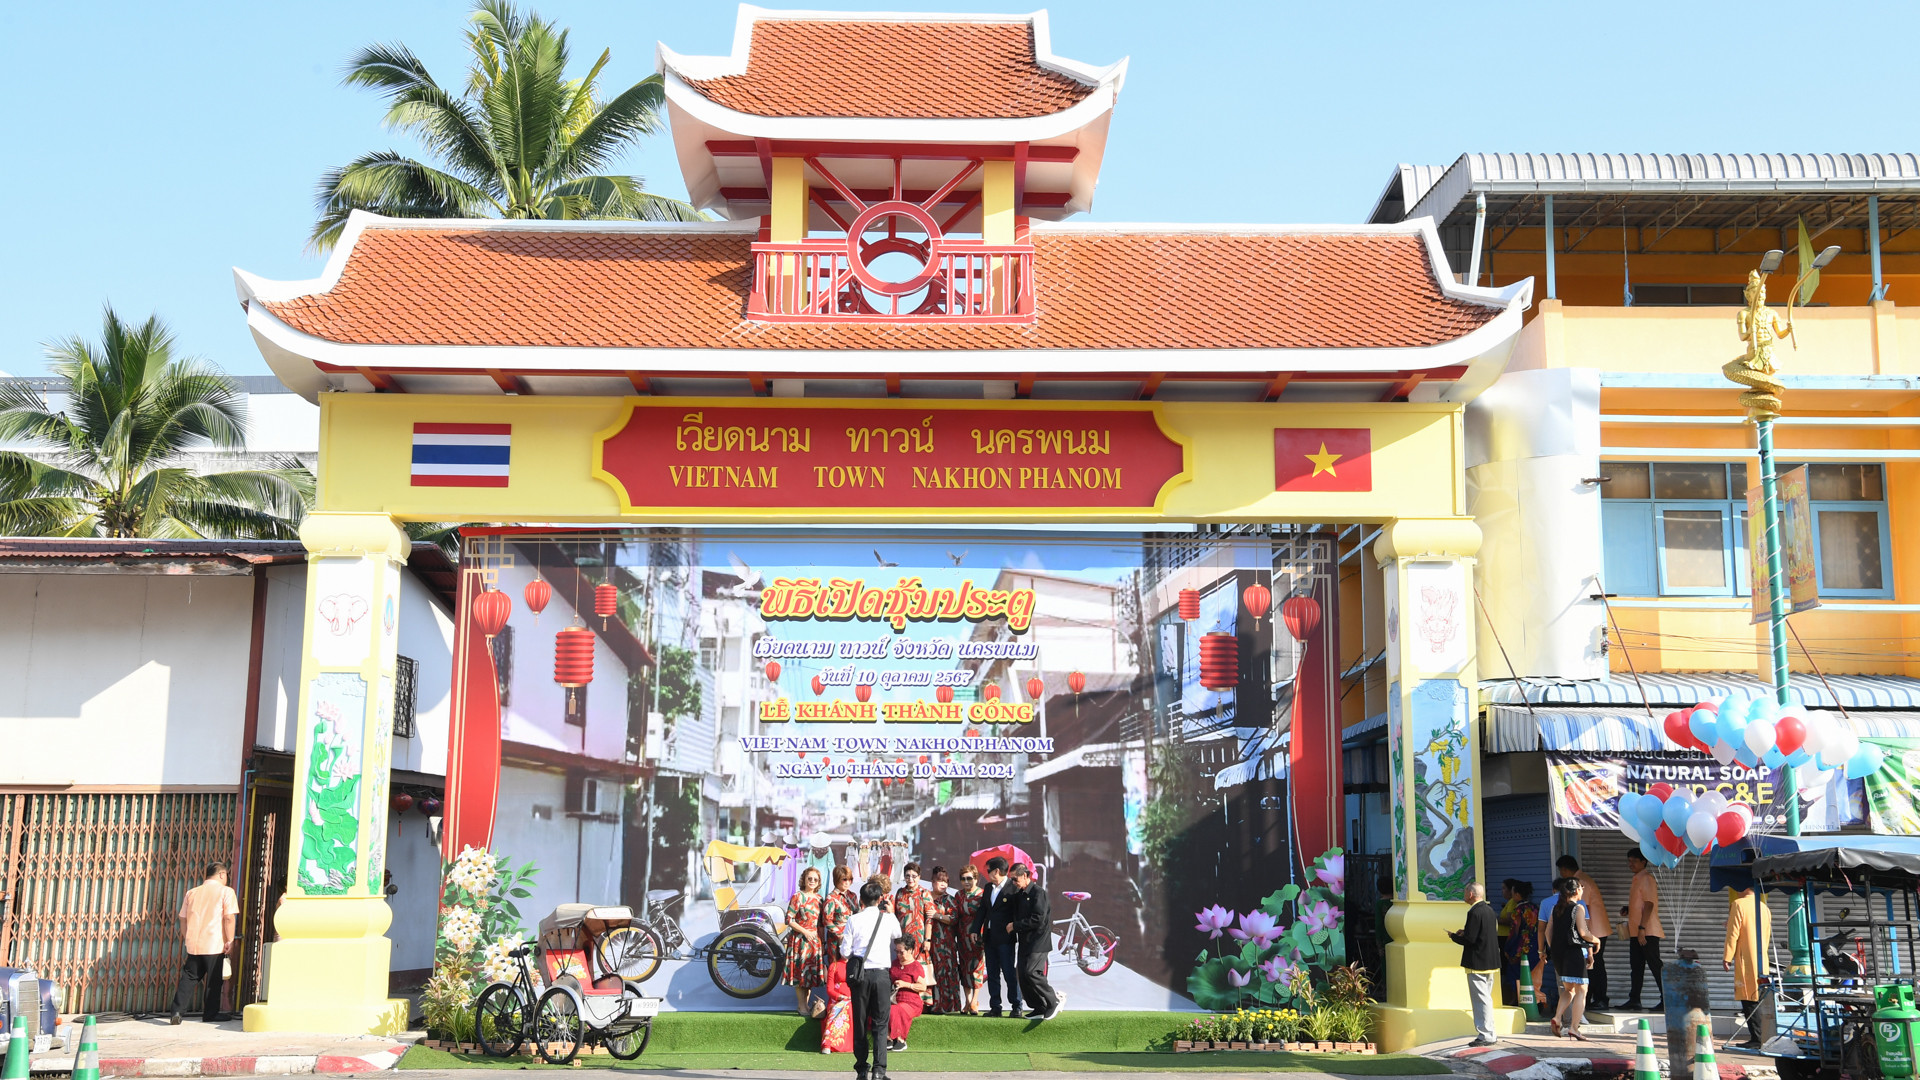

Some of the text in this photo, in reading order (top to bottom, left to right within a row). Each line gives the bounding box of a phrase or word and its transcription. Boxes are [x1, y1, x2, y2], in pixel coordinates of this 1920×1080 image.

[676, 412, 1110, 455] เวียดนาม ทาวน์ นครพนม
[668, 465, 1123, 490] VIETNAM TOWN NAKHON PHANOM
[761, 576, 1035, 630] พิธีเปิดซุ้มประตู
[754, 636, 1038, 657] เวียดนาม ทาวน์ จังหวัด นครพนม
[821, 665, 973, 688] วันที่ 10 ตุลาคม 2567
[762, 698, 1032, 720] LỄ KHÁNH THÀNH CỔNG
[835, 737, 889, 750] TOWN
[895, 738, 1052, 751] NAKHONPHANOM
[779, 761, 1014, 776] NGÀY 10 THÁNG 10 NĂM 2024
[1626, 764, 1715, 781] NATURAL
[1719, 766, 1772, 781] SOAP
